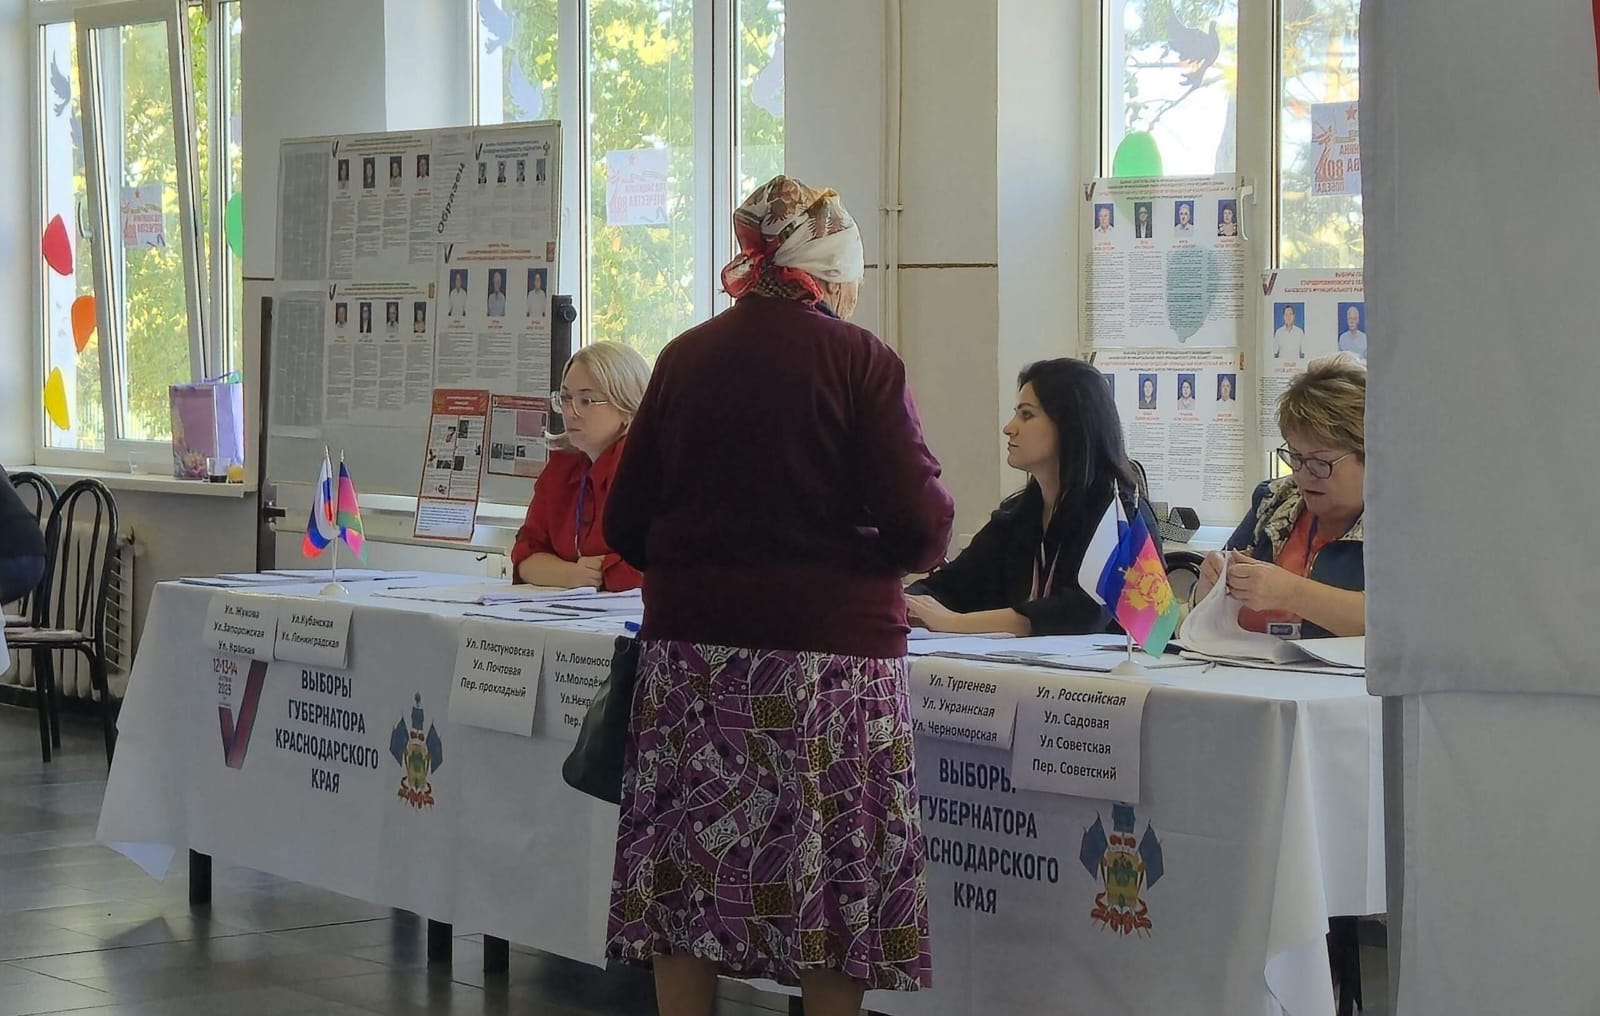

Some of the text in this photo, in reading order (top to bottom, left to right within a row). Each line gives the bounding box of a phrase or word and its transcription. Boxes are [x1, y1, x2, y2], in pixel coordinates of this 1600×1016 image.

[437, 163, 465, 234] Образец
[235, 606, 260, 619] Жукова
[465, 637, 535, 658] Ул. Пластуновская
[472, 658, 522, 677] Ул. Почтовая
[555, 651, 610, 668] Ул. Ломоносо
[301, 669, 352, 699] ВЫБОРЫ
[460, 677, 478, 692] Пер.
[555, 671, 601, 689] Ул.Молодё
[929, 673, 997, 694] Ул. Тургенева
[560, 692, 592, 709] Ул.Некр
[922, 696, 996, 718] Ул. Украинская
[1057, 688, 1127, 708] Росссийская
[288, 698, 366, 734] ГУБЕРНАТОРА
[564, 713, 581, 729] Пер.
[1044, 710, 1110, 730] Ул. Садовая
[912, 718, 998, 743] Ул. Черноморская
[275, 727, 379, 770] КРАСНОДАРСКОГО
[1039, 734, 1112, 755] Ул Советская
[1032, 758, 1118, 781] Пер. Советский
[311, 768, 340, 794] КРАЯ
[919, 795, 1038, 839] ГУБЕРНАТОРА
[922, 836, 1059, 884] АСНОДАРСКОГО
[953, 881, 997, 914] КРАЯ
